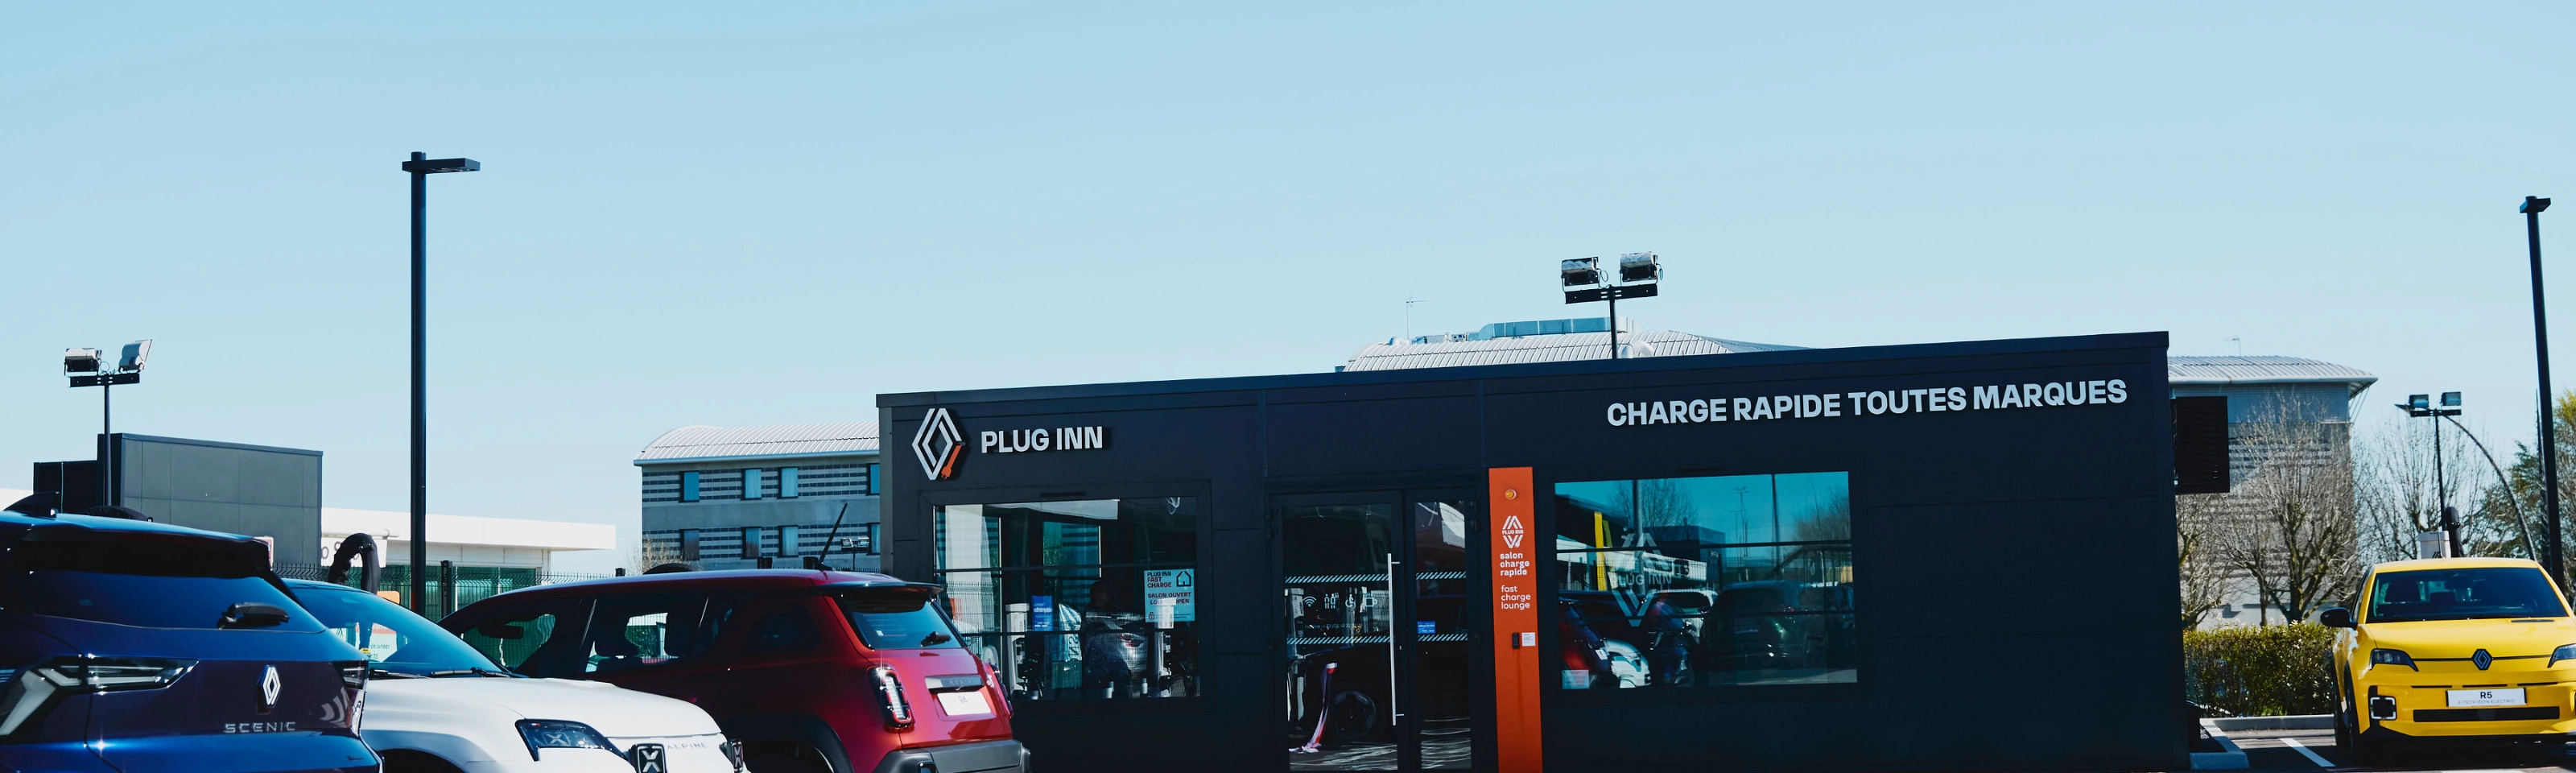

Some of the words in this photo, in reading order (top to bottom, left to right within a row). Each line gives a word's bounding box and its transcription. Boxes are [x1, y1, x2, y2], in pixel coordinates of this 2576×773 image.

[1607, 398, 1728, 427] CHARGE
[1732, 393, 1841, 421] RAPIDE
[1847, 386, 1967, 415] TOUTES
[1973, 379, 2128, 410] MARQUES
[980, 428, 1050, 454] PLUG
[1056, 426, 1103, 451] INN
[1500, 552, 1524, 560] salon
[1500, 560, 1530, 569] charge
[1500, 568, 1528, 578] rapide
[1648, 572, 1673, 585] INN
[1501, 585, 1518, 593] fast
[1501, 593, 1531, 602] charge
[1501, 601, 1530, 610] lounge
[224, 721, 296, 734] SCENIC
[667, 742, 708, 750] ALPINE
